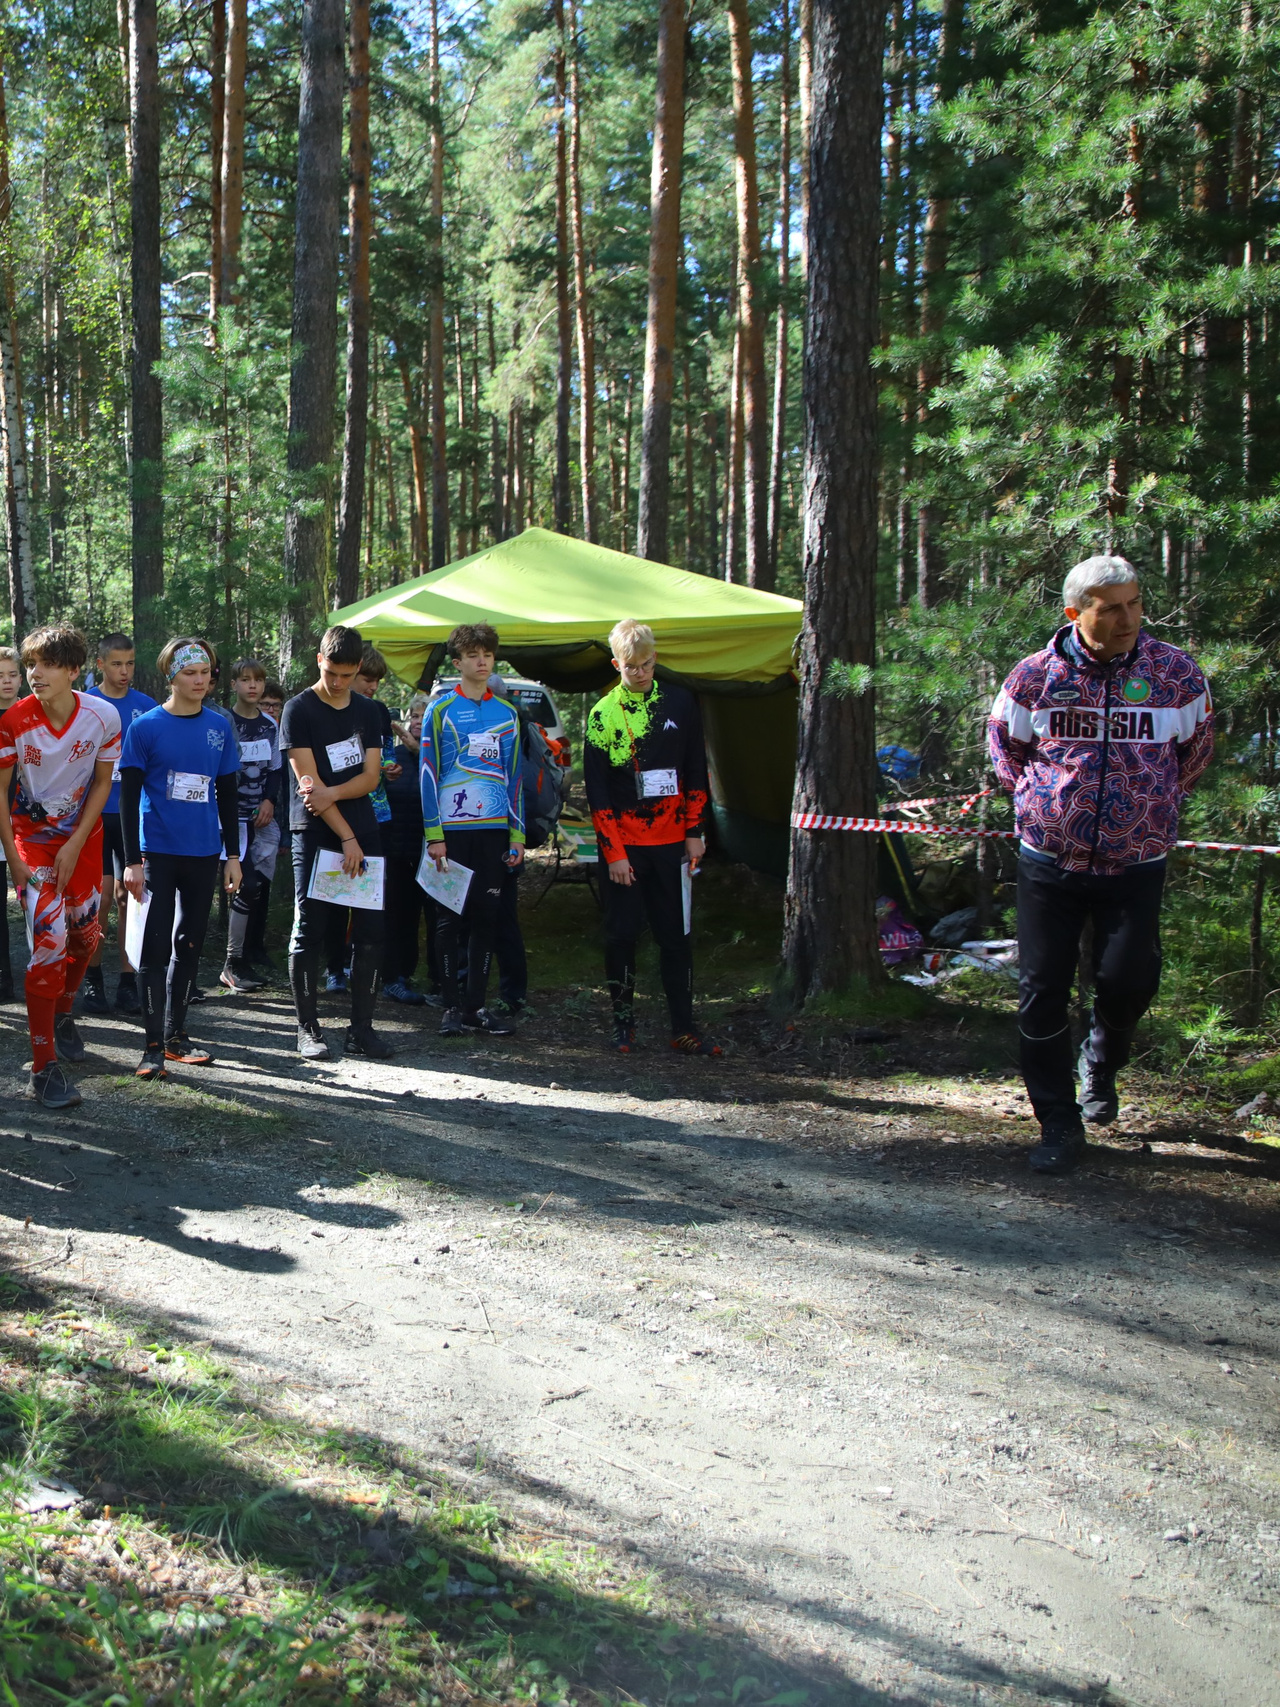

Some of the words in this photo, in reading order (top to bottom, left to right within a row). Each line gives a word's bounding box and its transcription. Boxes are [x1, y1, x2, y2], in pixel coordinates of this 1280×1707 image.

[1050, 710, 1155, 740] RUSSIA
[481, 748, 498, 759] 209
[344, 753, 360, 767] 207
[186, 789, 205, 801] 206
[660, 784, 676, 795] 210
